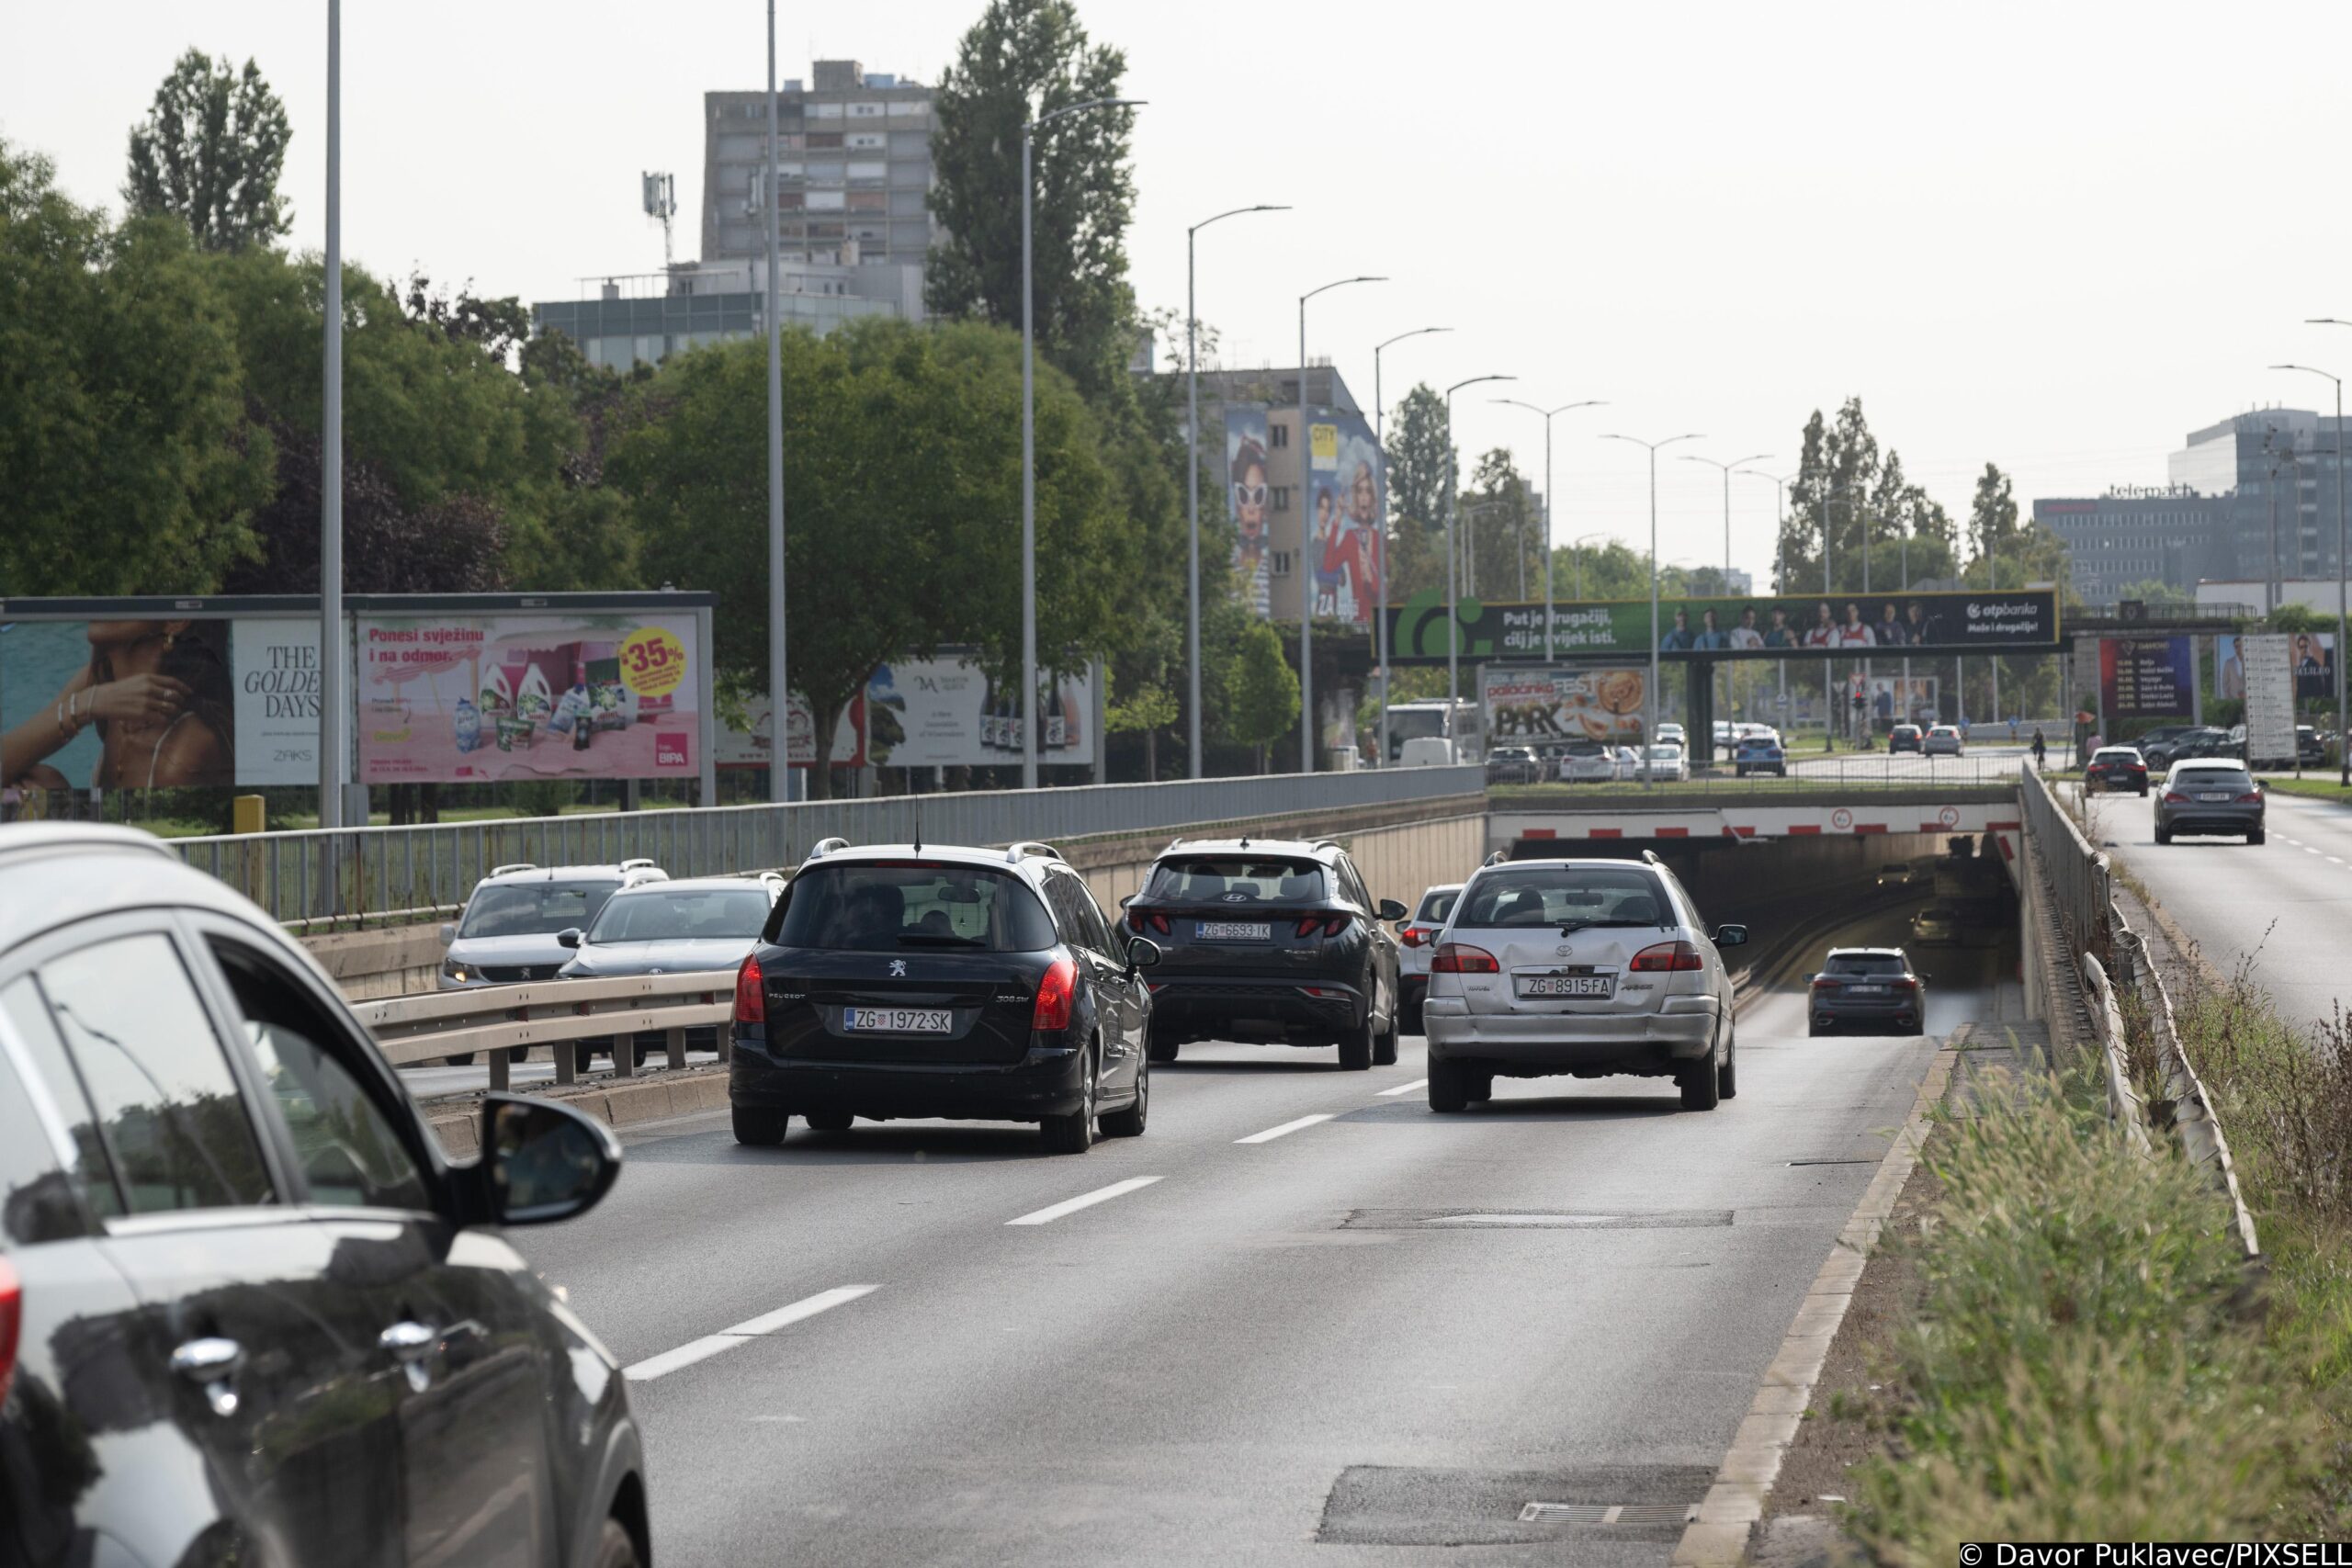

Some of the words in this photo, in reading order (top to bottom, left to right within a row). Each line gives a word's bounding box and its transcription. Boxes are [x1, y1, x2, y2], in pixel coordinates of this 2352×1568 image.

[2109, 482, 2195, 500] telemach
[1503, 611, 1529, 626] Put
[1529, 609, 1544, 629] je
[369, 627, 419, 642] Ponesi
[423, 627, 484, 644] svježinu
[1589, 628, 1617, 645] isti.
[266, 645, 316, 670] THE
[369, 649, 374, 662] i
[379, 650, 397, 662] na
[401, 649, 453, 663] odmor.
[244, 670, 322, 694] GOLDE
[266, 694, 322, 718] DAYS
[1496, 703, 1563, 736] PARK
[659, 752, 684, 764] BIPA
[1204, 924, 1218, 936] ZG
[1529, 979, 1546, 993] ZG
[996, 995, 1015, 1003] 308
[856, 1011, 876, 1028] ZG
